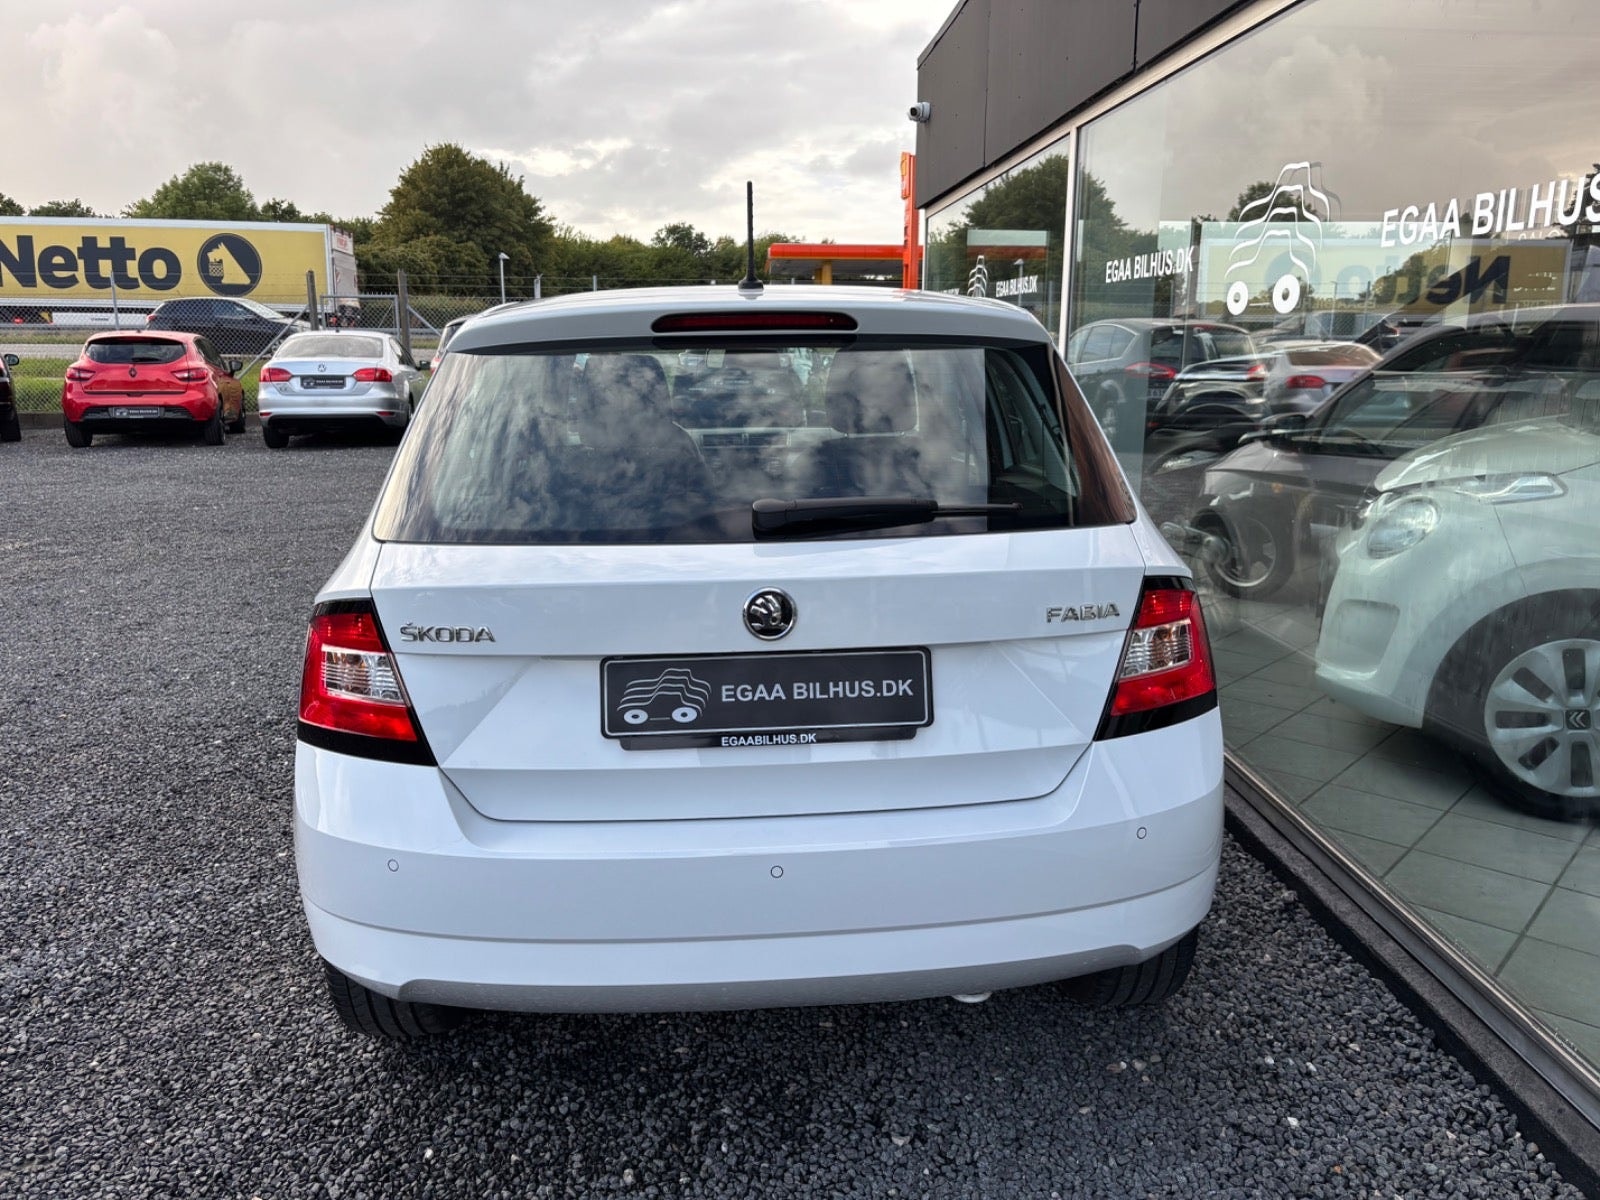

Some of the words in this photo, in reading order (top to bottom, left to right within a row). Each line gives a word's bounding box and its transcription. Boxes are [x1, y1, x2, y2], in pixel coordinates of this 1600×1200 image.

[1380, 197, 1461, 248] EGAA
[0, 234, 182, 290] Netto
[1105, 256, 1132, 284] EGAA
[1133, 245, 1195, 279] BILHUS.DK
[1046, 603, 1120, 623] FABIA
[400, 621, 496, 642] ŠKODA
[721, 683, 786, 702] EGAA
[793, 679, 914, 700] BILHUS.DK
[721, 733, 817, 747] EGAABILHUS.DK
